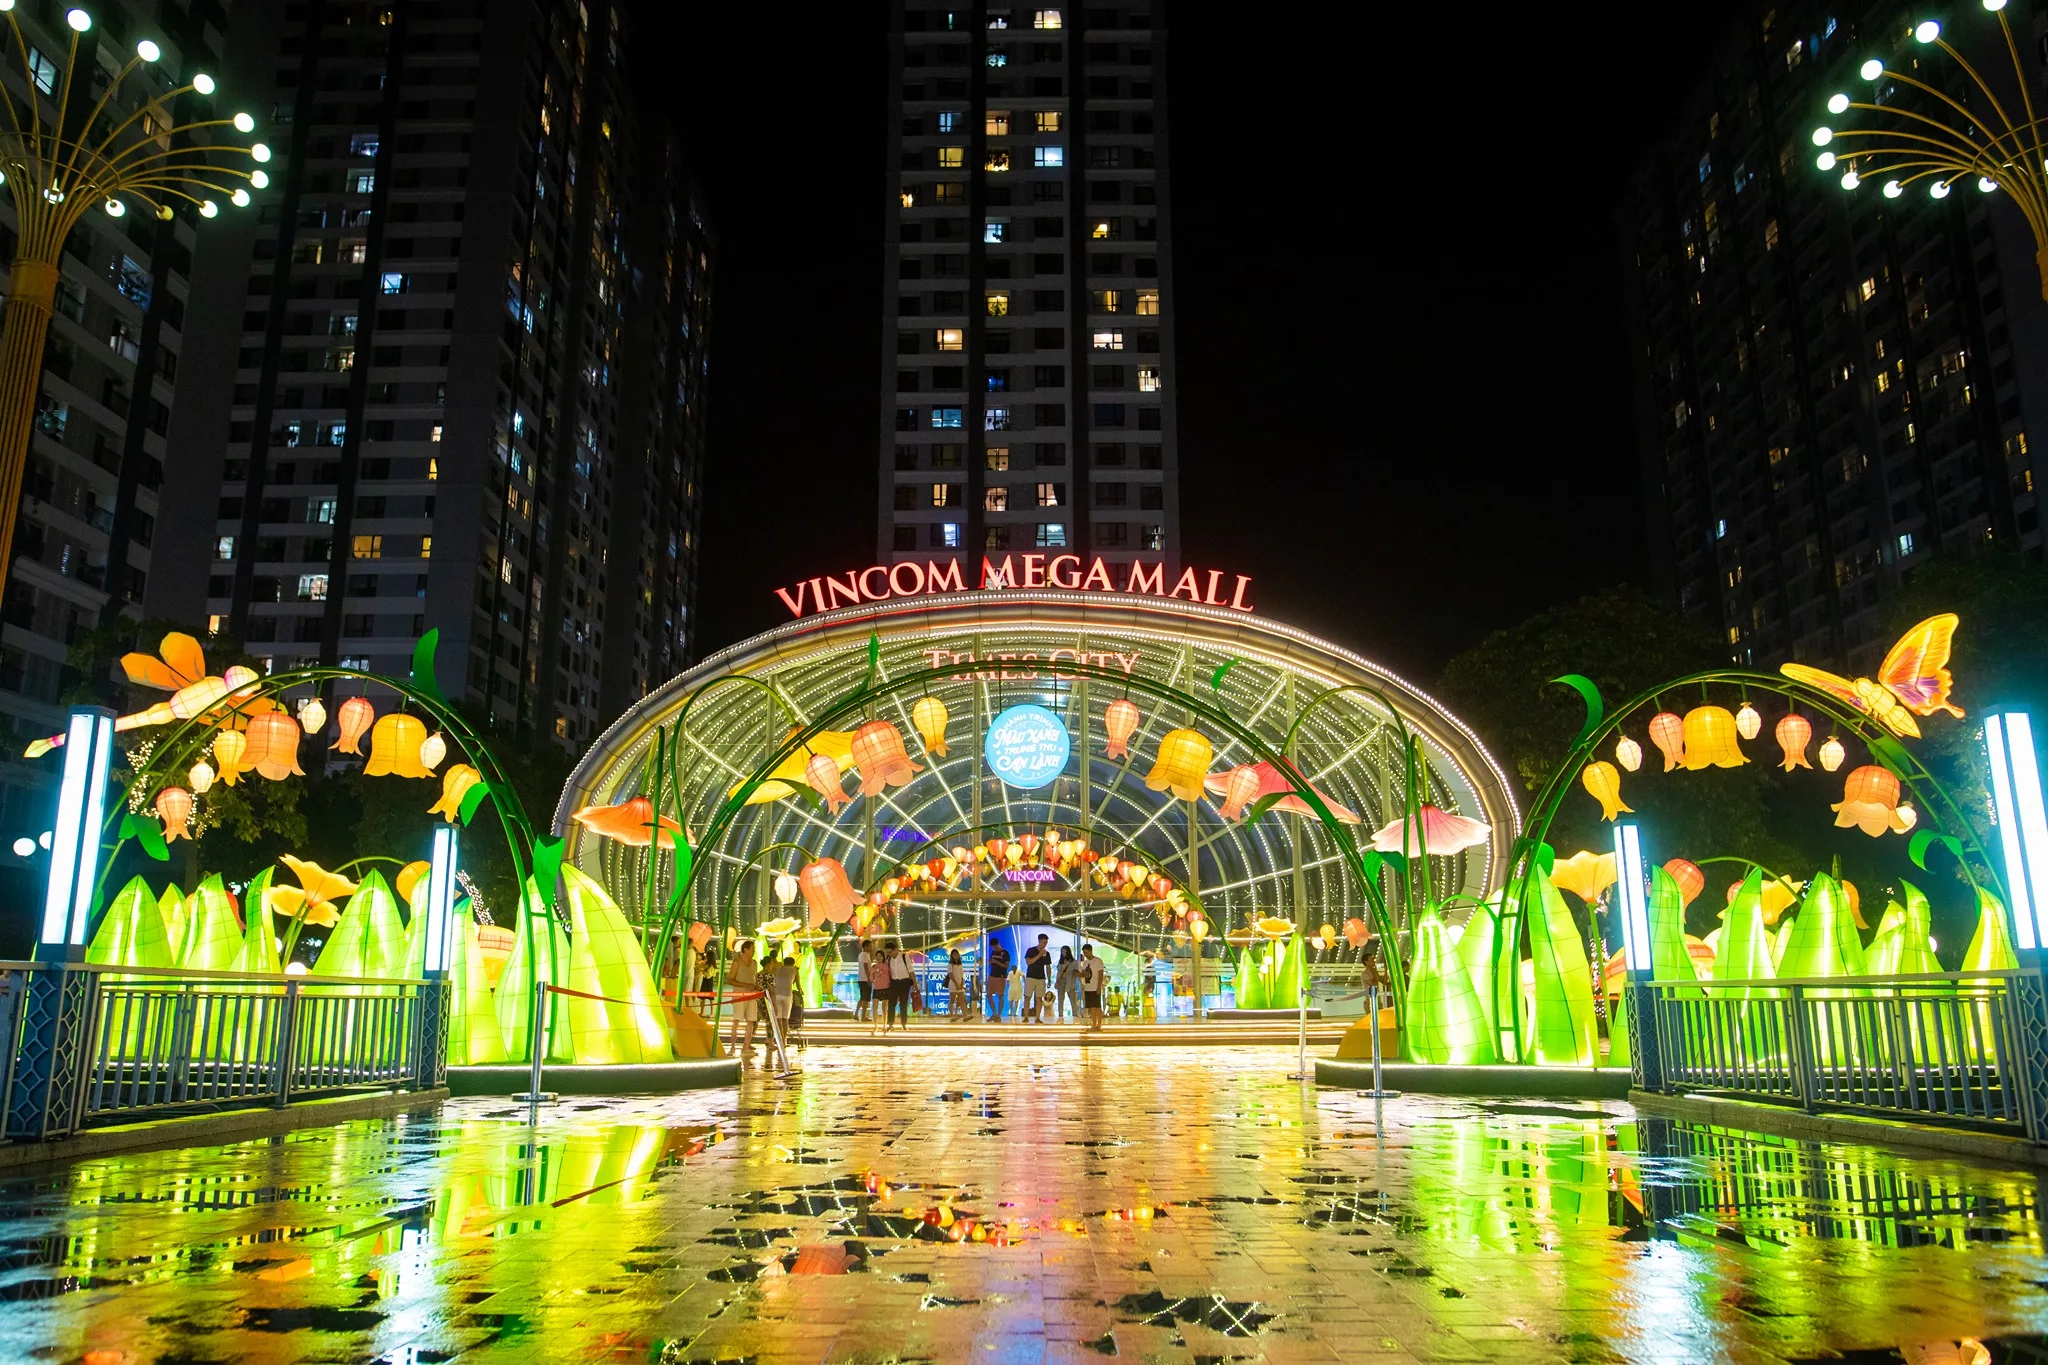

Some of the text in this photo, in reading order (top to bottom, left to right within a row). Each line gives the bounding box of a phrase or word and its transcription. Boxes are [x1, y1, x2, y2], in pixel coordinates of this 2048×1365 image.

[773, 553, 1254, 619] VINCOM MEGA MALL
[1004, 743, 1058, 755] TRUNG THU
[1003, 870, 1056, 882] VINCOM
